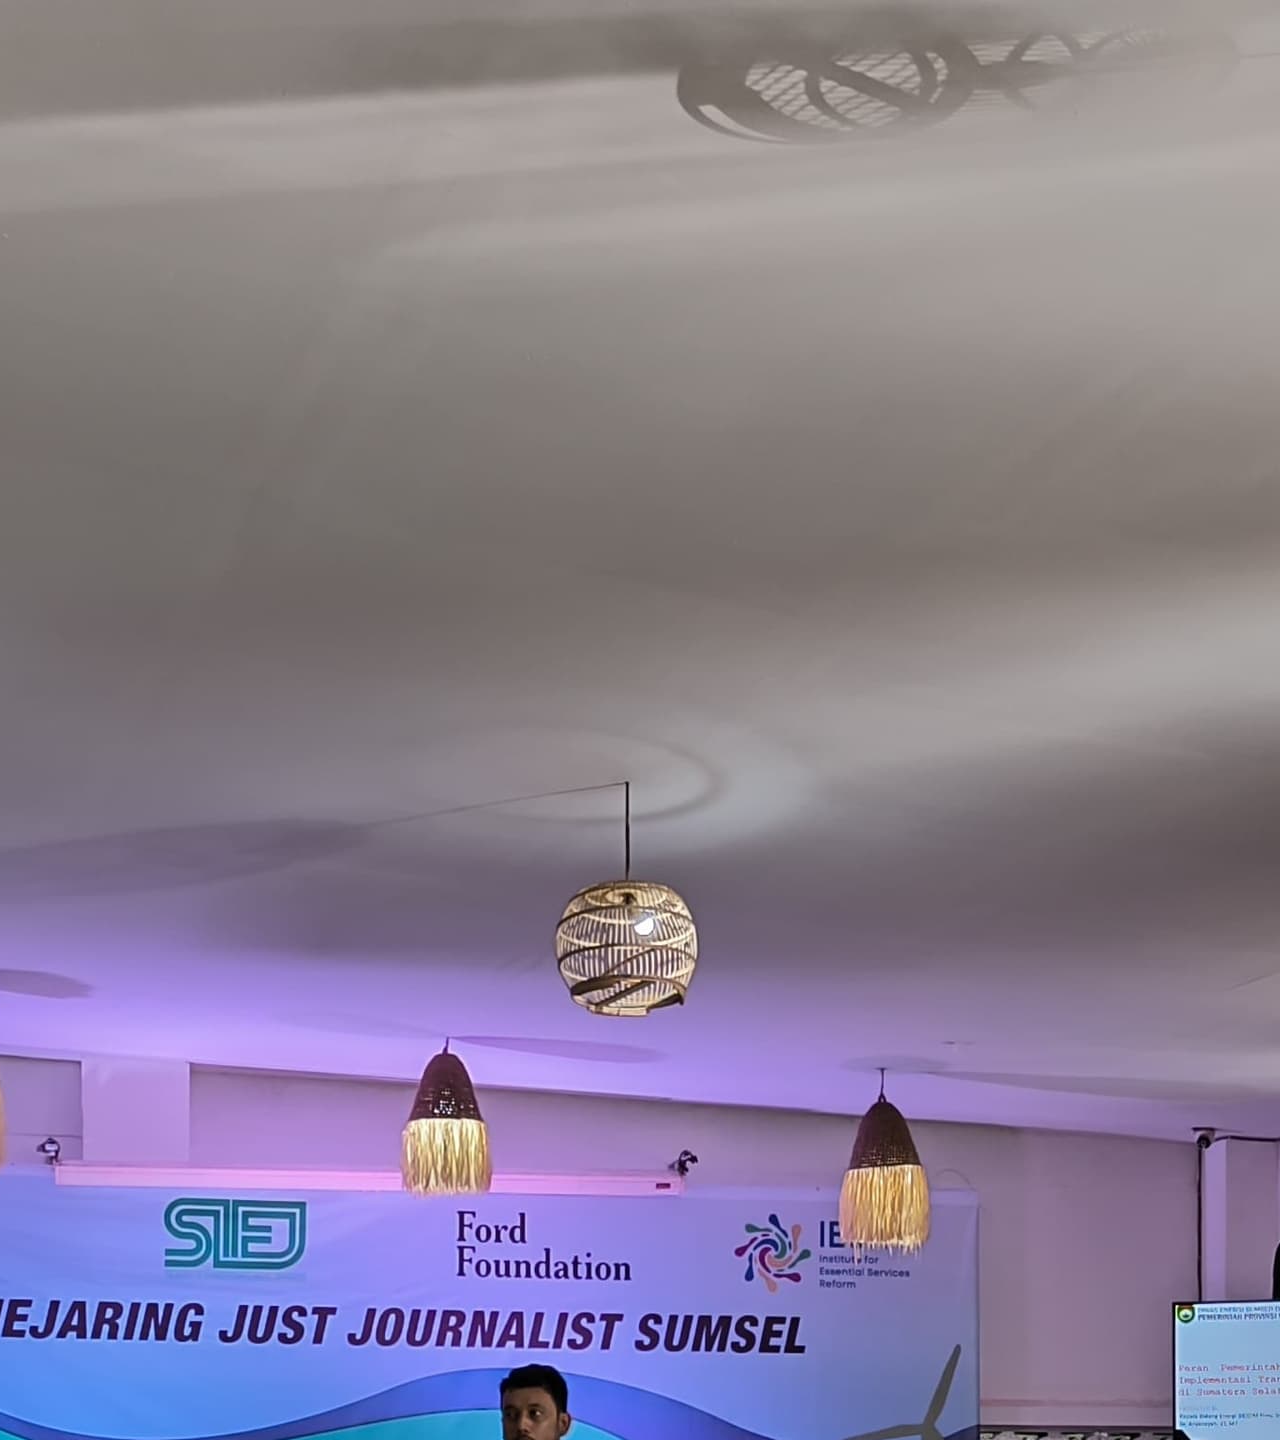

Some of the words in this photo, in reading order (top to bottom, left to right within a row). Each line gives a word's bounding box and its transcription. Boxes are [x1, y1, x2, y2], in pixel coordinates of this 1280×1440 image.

[456, 1210, 528, 1244] Ford
[456, 1245, 632, 1281] Foundation
[864, 1255, 879, 1264] for
[819, 1267, 865, 1277] Essential
[867, 1268, 910, 1278] Services
[819, 1279, 857, 1289] Reform
[218, 1303, 338, 1346] JUST
[346, 1306, 624, 1352] JOURNALIST
[634, 1312, 807, 1355] SUMSEL
